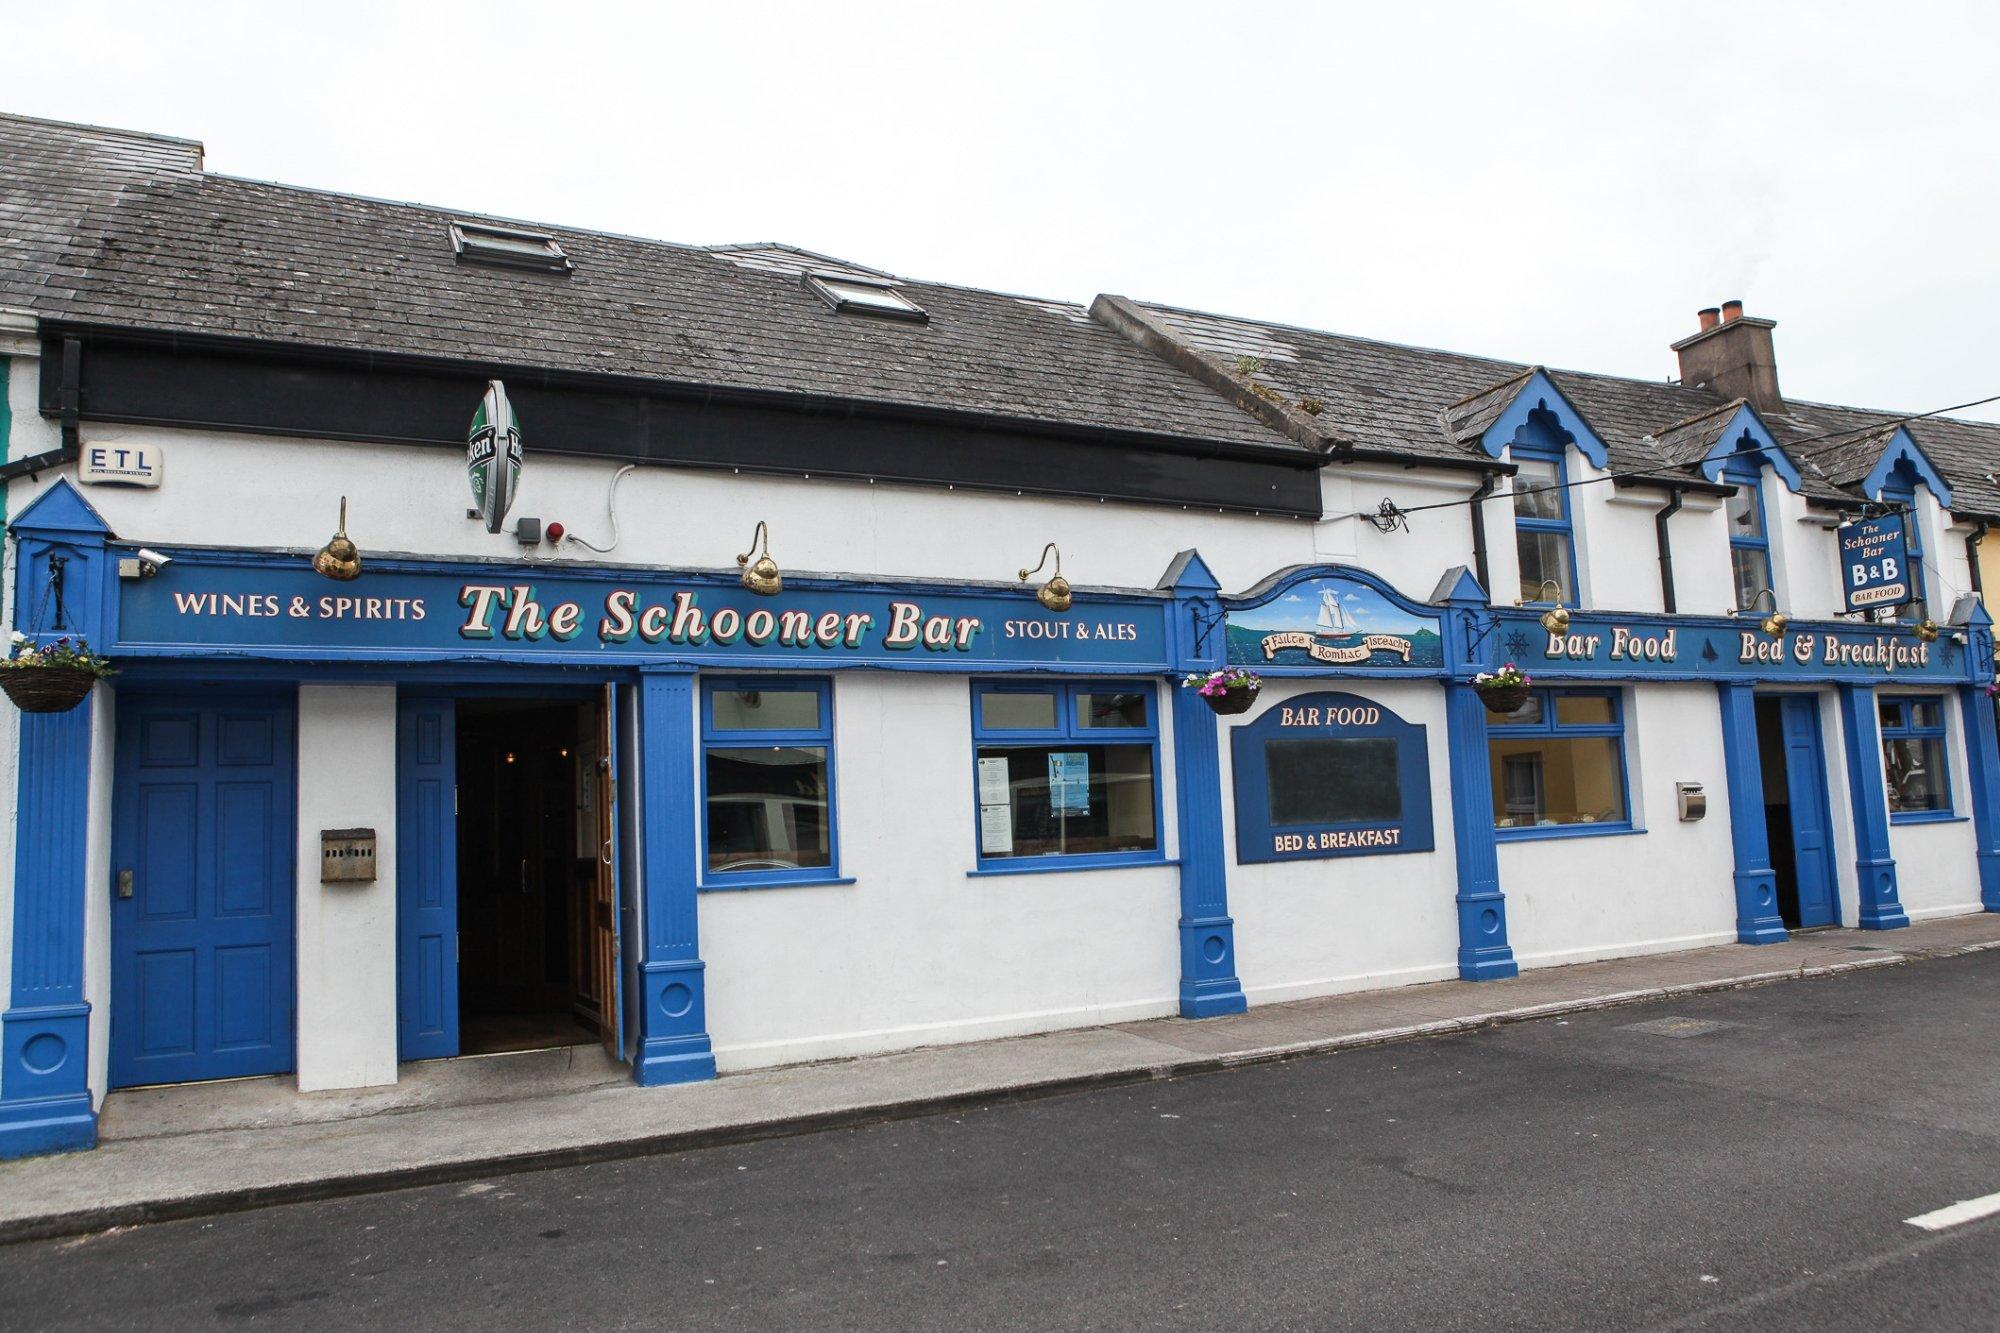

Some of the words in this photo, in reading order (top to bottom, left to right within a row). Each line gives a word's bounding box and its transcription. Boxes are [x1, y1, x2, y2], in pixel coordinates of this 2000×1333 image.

[90, 448, 152, 470] ETL
[1844, 530, 1900, 550] Schooner
[1861, 525, 1879, 535] The
[1861, 547, 1884, 559] Bar
[1854, 591, 1873, 602] BAR
[1874, 586, 1901, 599] FOOD
[173, 592, 280, 617] WINES
[288, 595, 311, 618] &
[318, 596, 427, 620] SPIRITS
[460, 584, 584, 640] The
[598, 589, 875, 648] Schooner
[884, 601, 984, 651] Bar
[1005, 620, 1070, 639] STOUT
[1076, 622, 1090, 639] &
[1094, 623, 1137, 641] ALES
[1317, 645, 1362, 660] Romhat
[1368, 636, 1403, 650] Isteach
[1545, 632, 1600, 659] Bar
[1610, 628, 1677, 661] Food
[1739, 632, 1784, 664] Bed
[1793, 634, 1815, 665] &
[1824, 635, 1929, 672] Breakfast
[1280, 707, 1320, 726] BAR
[1325, 706, 1380, 726] FOOD
[1275, 835, 1303, 852] BED
[1306, 834, 1317, 850] &
[1320, 829, 1400, 849] BREAKFAST
